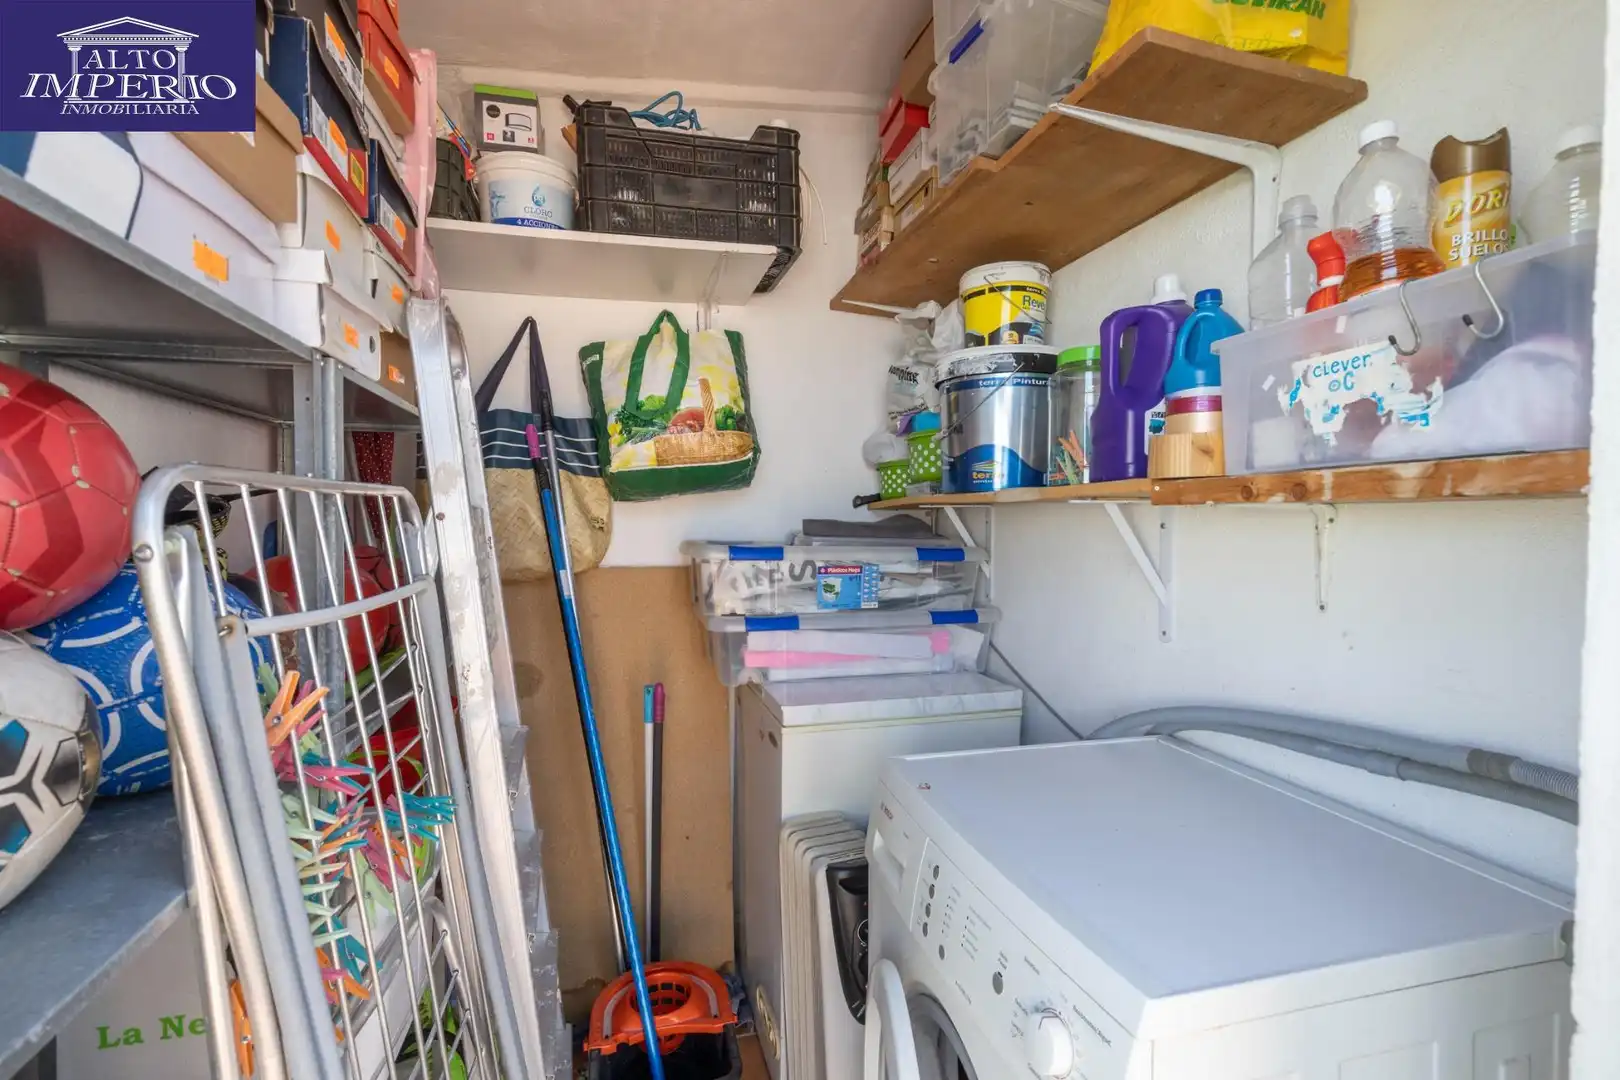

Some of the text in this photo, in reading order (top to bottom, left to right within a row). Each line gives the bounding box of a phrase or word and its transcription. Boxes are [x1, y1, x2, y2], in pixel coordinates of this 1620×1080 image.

[1451, 228, 1509, 247] BRILLO
[95, 1014, 207, 1050] La Ne
